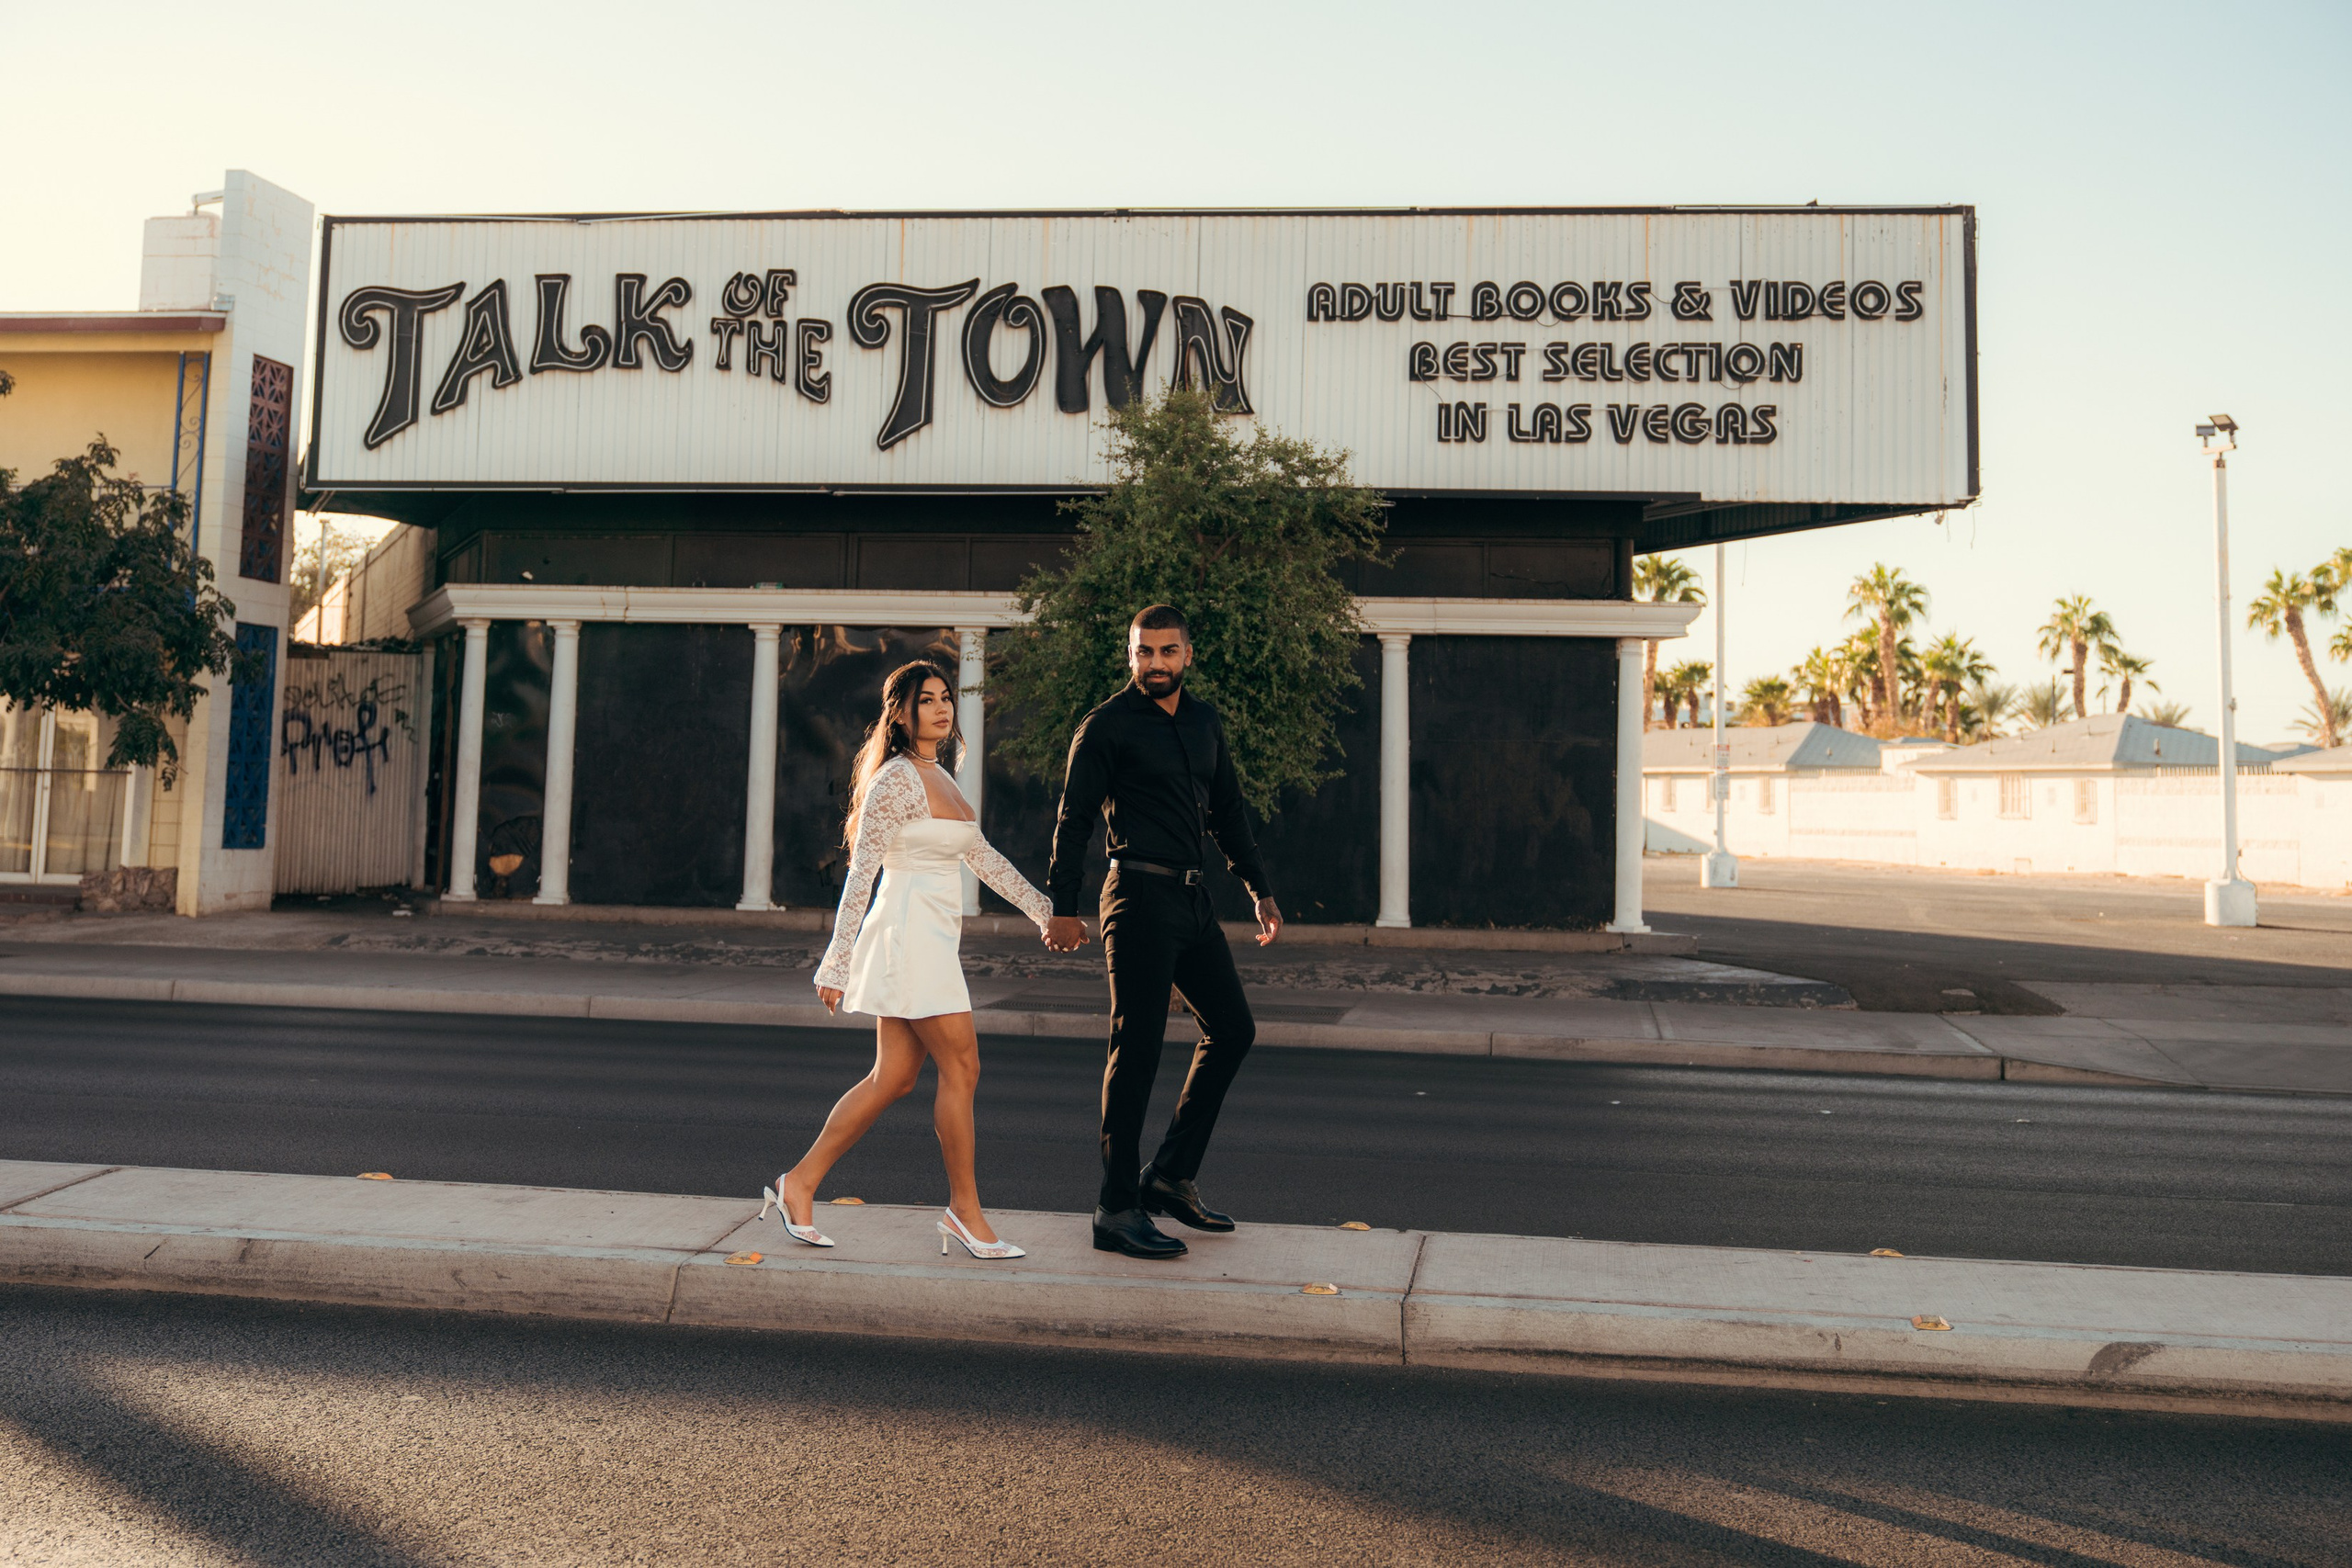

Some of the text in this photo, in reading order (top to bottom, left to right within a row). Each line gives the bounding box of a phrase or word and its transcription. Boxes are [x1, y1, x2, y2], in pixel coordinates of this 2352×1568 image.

[1307, 280, 1923, 321] ADULT BOOKS & VIDEOS
[339, 268, 1254, 451] TALK OF THE TOWN
[1409, 342, 1804, 382] BEST SELECTION
[1438, 402, 1777, 444] IN LAS VEGAS
